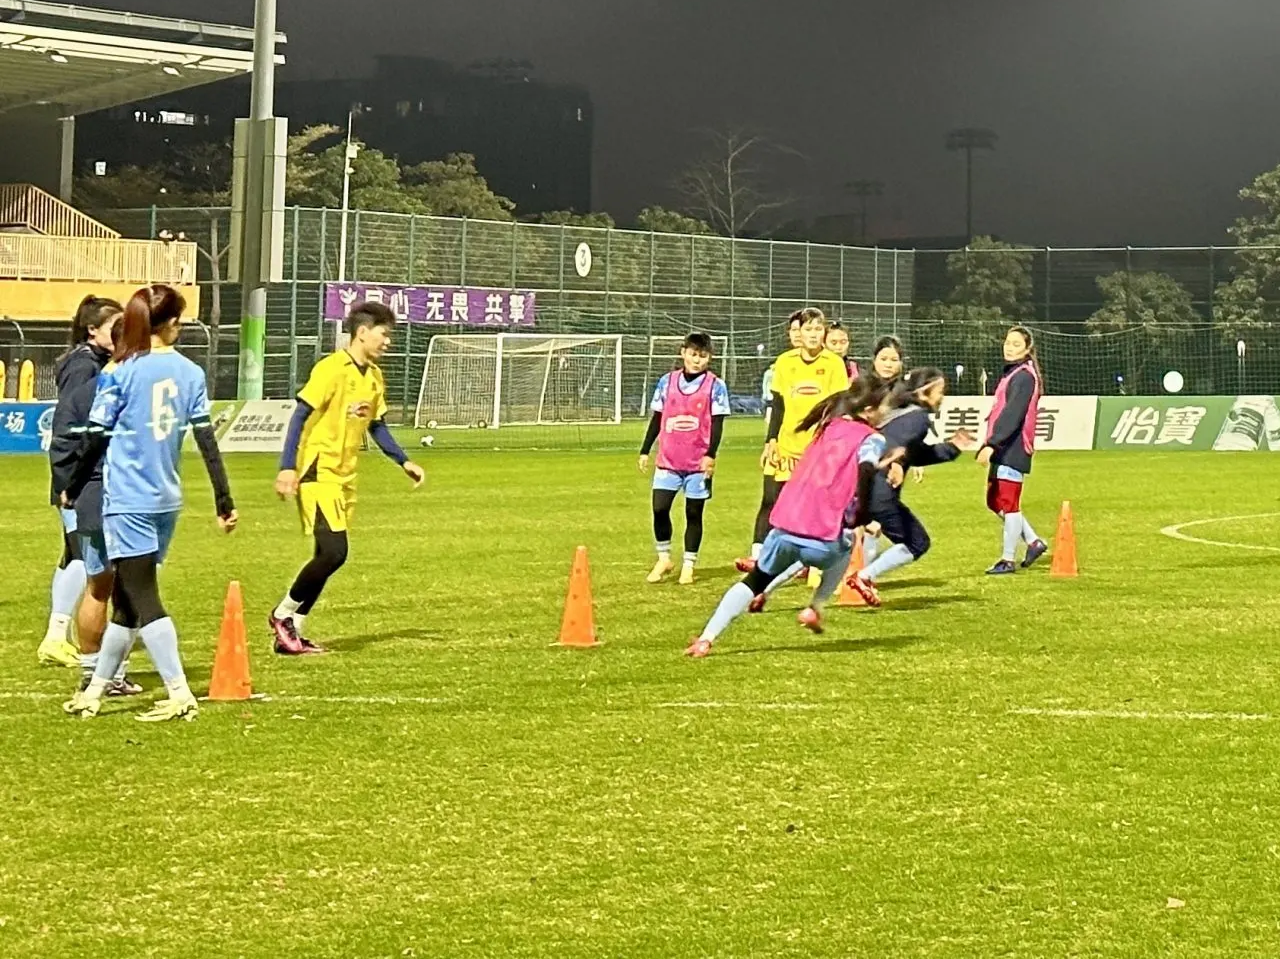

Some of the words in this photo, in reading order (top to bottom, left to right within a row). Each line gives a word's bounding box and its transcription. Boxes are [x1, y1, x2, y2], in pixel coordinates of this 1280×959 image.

[426, 292, 469, 322] 无畏
[484, 293, 525, 323] 共擎
[152, 378, 179, 441] 6
